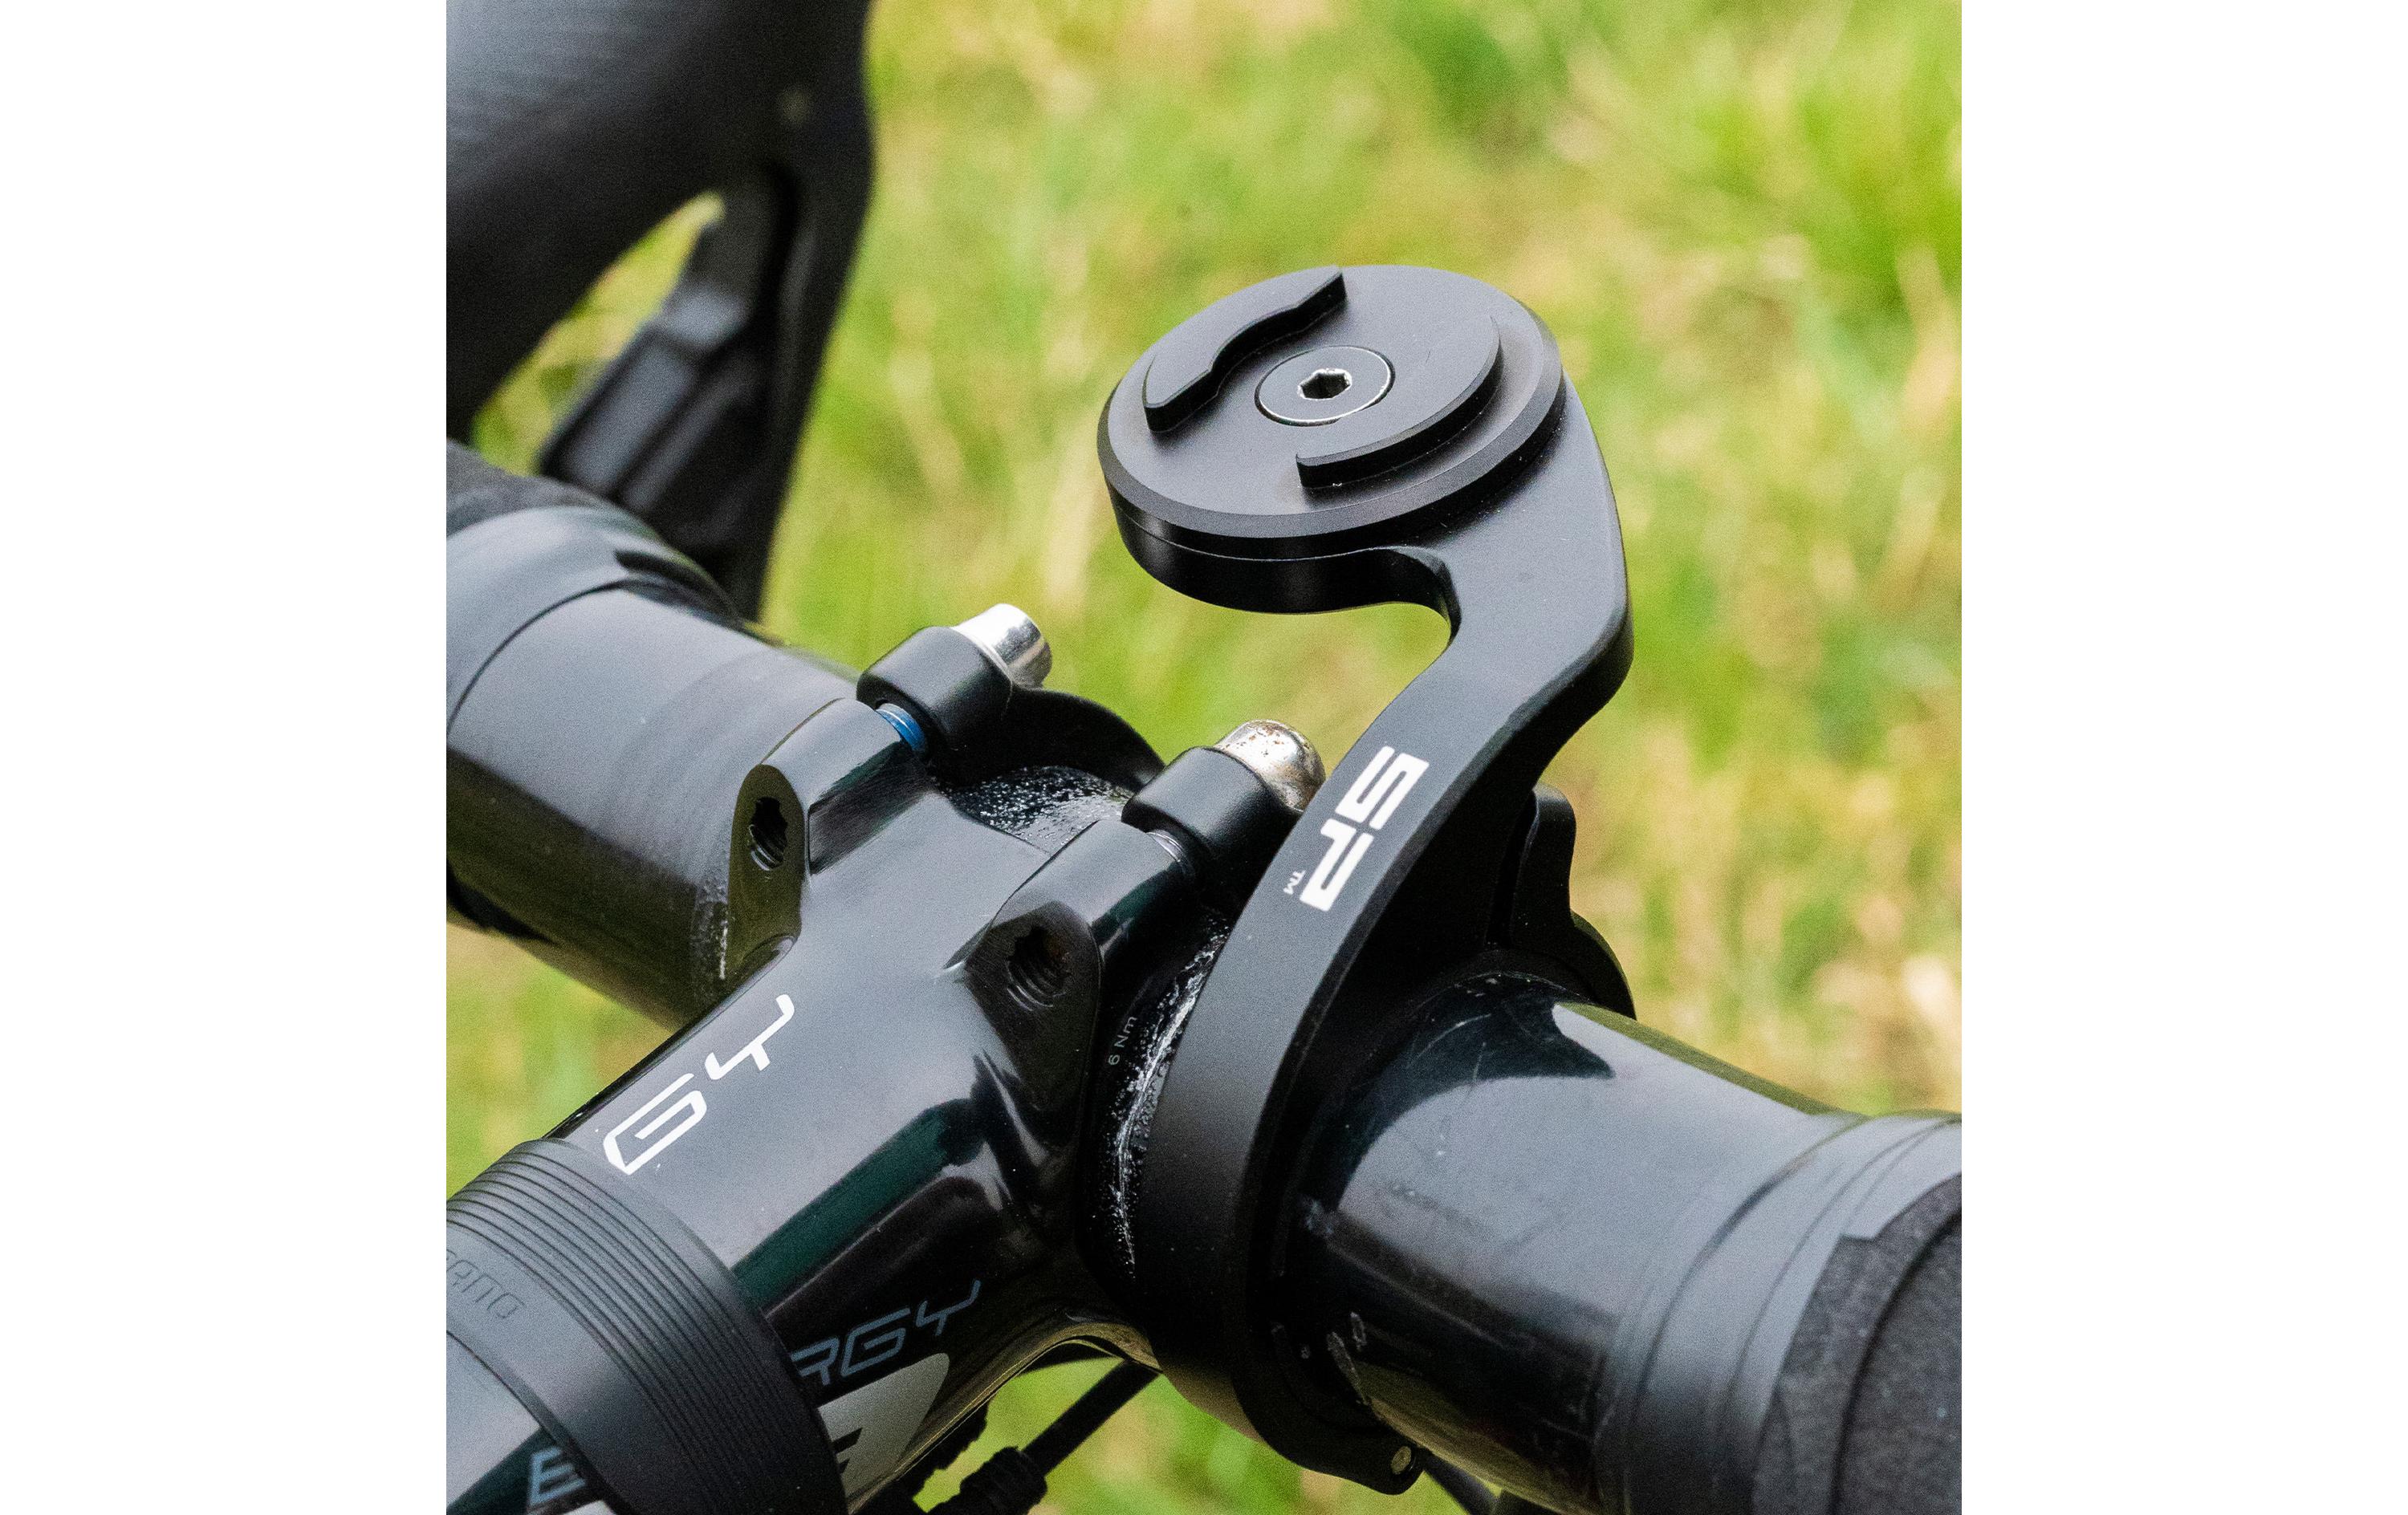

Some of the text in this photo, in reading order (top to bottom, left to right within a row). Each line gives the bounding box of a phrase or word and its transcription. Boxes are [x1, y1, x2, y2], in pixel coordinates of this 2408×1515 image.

[1300, 745, 1430, 912] SP
[1108, 1017, 1137, 1065] 6 Nm
